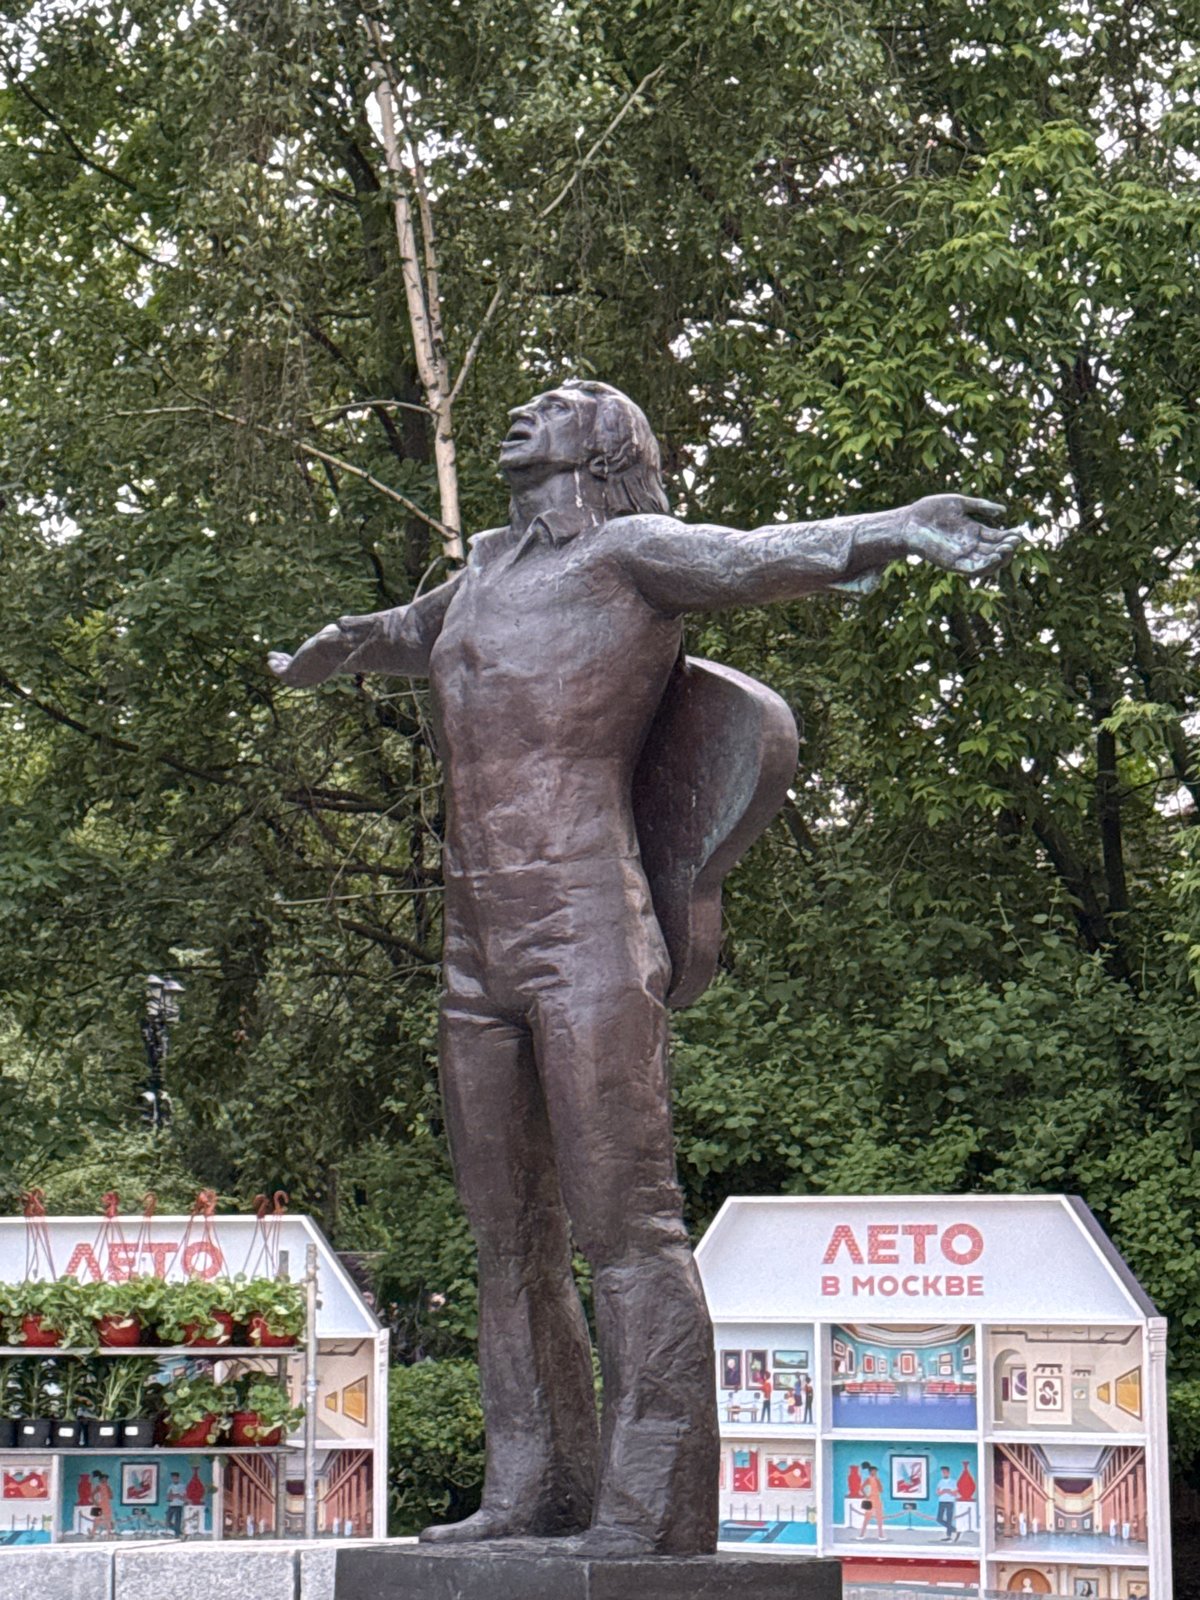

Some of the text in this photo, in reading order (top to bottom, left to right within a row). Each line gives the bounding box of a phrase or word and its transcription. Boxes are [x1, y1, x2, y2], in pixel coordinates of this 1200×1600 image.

[66, 1242, 223, 1281] ЛЕТО
[822, 1223, 984, 1265] ЛЕТО
[821, 1276, 984, 1296] В МОСКВЕ
